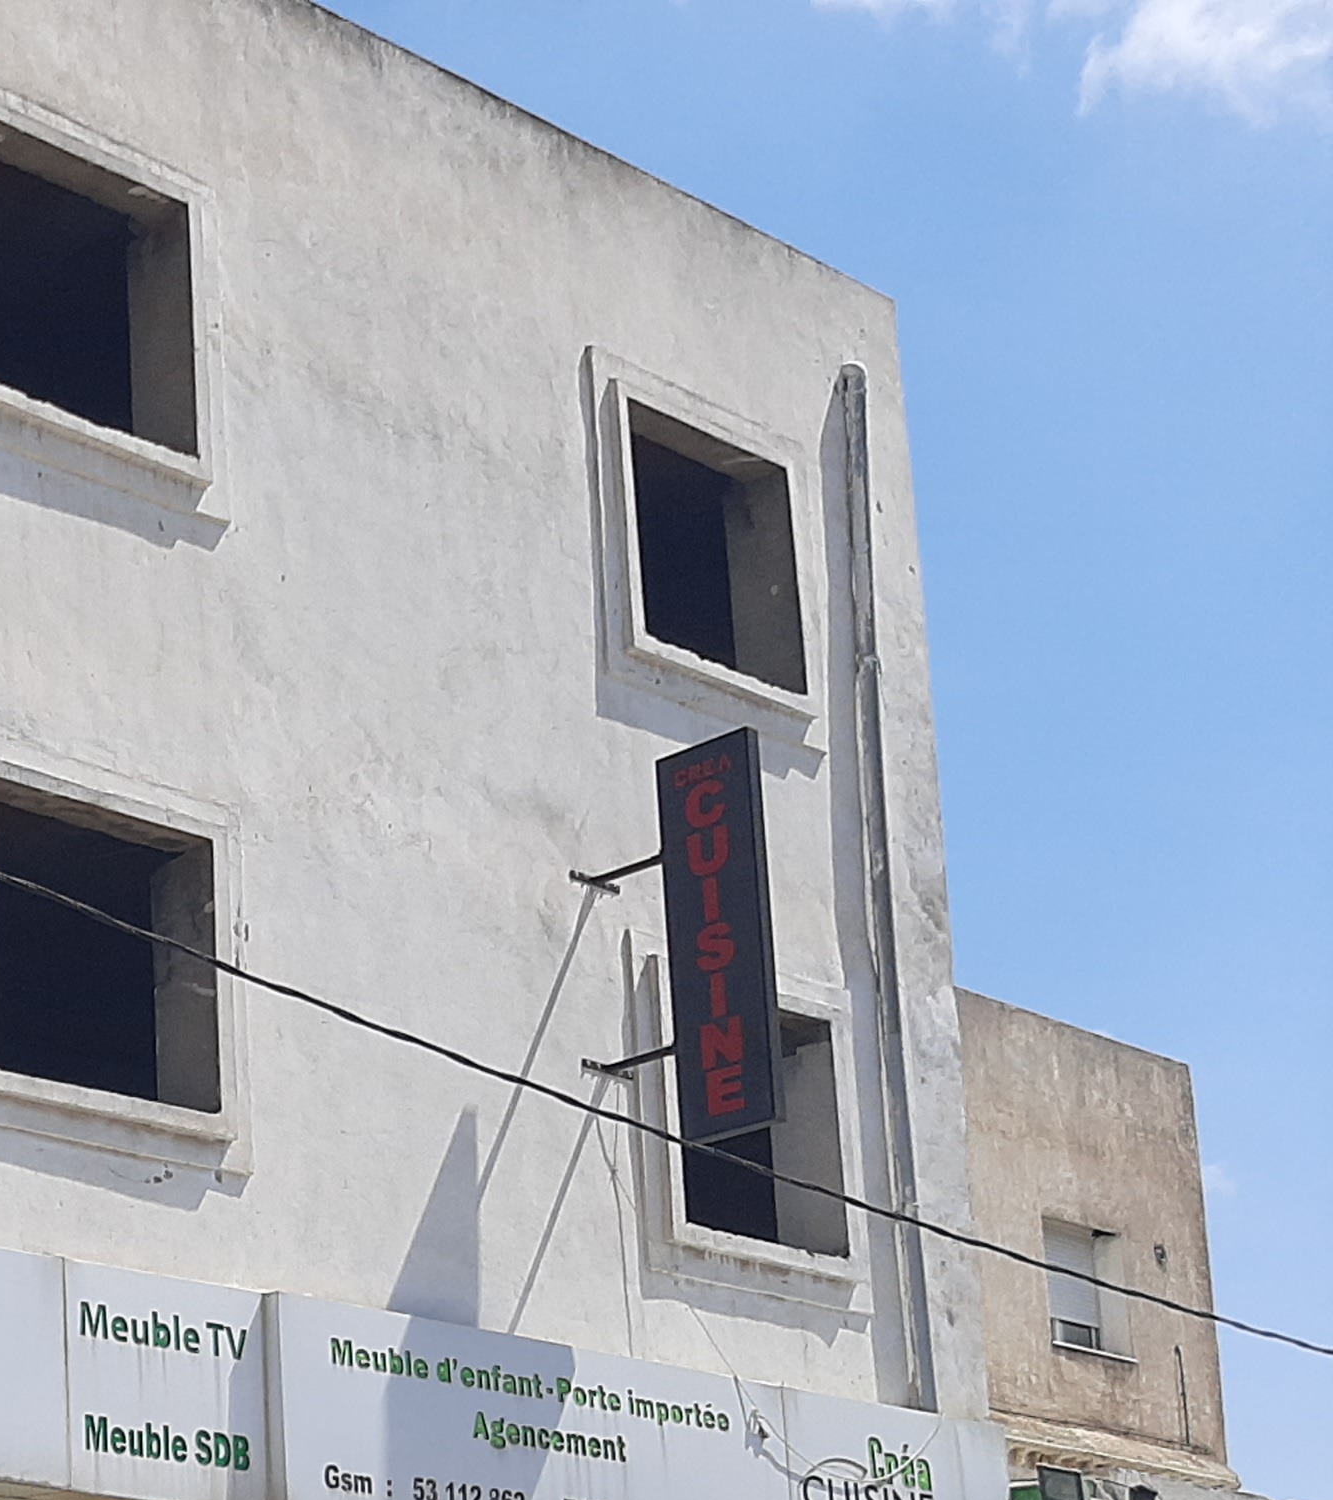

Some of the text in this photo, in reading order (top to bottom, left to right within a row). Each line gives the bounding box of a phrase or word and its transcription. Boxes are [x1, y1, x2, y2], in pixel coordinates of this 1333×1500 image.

[685, 779, 747, 1117] CUISINE
[79, 1301, 247, 1361] Meuble TV
[330, 1337, 429, 1380] Meuble
[627, 1389, 731, 1433] importée
[84, 1413, 251, 1471] Meuble SDB
[472, 1410, 628, 1463] Agencement
[868, 1436, 933, 1491] Créa
[324, 1464, 373, 1495] Gsm
